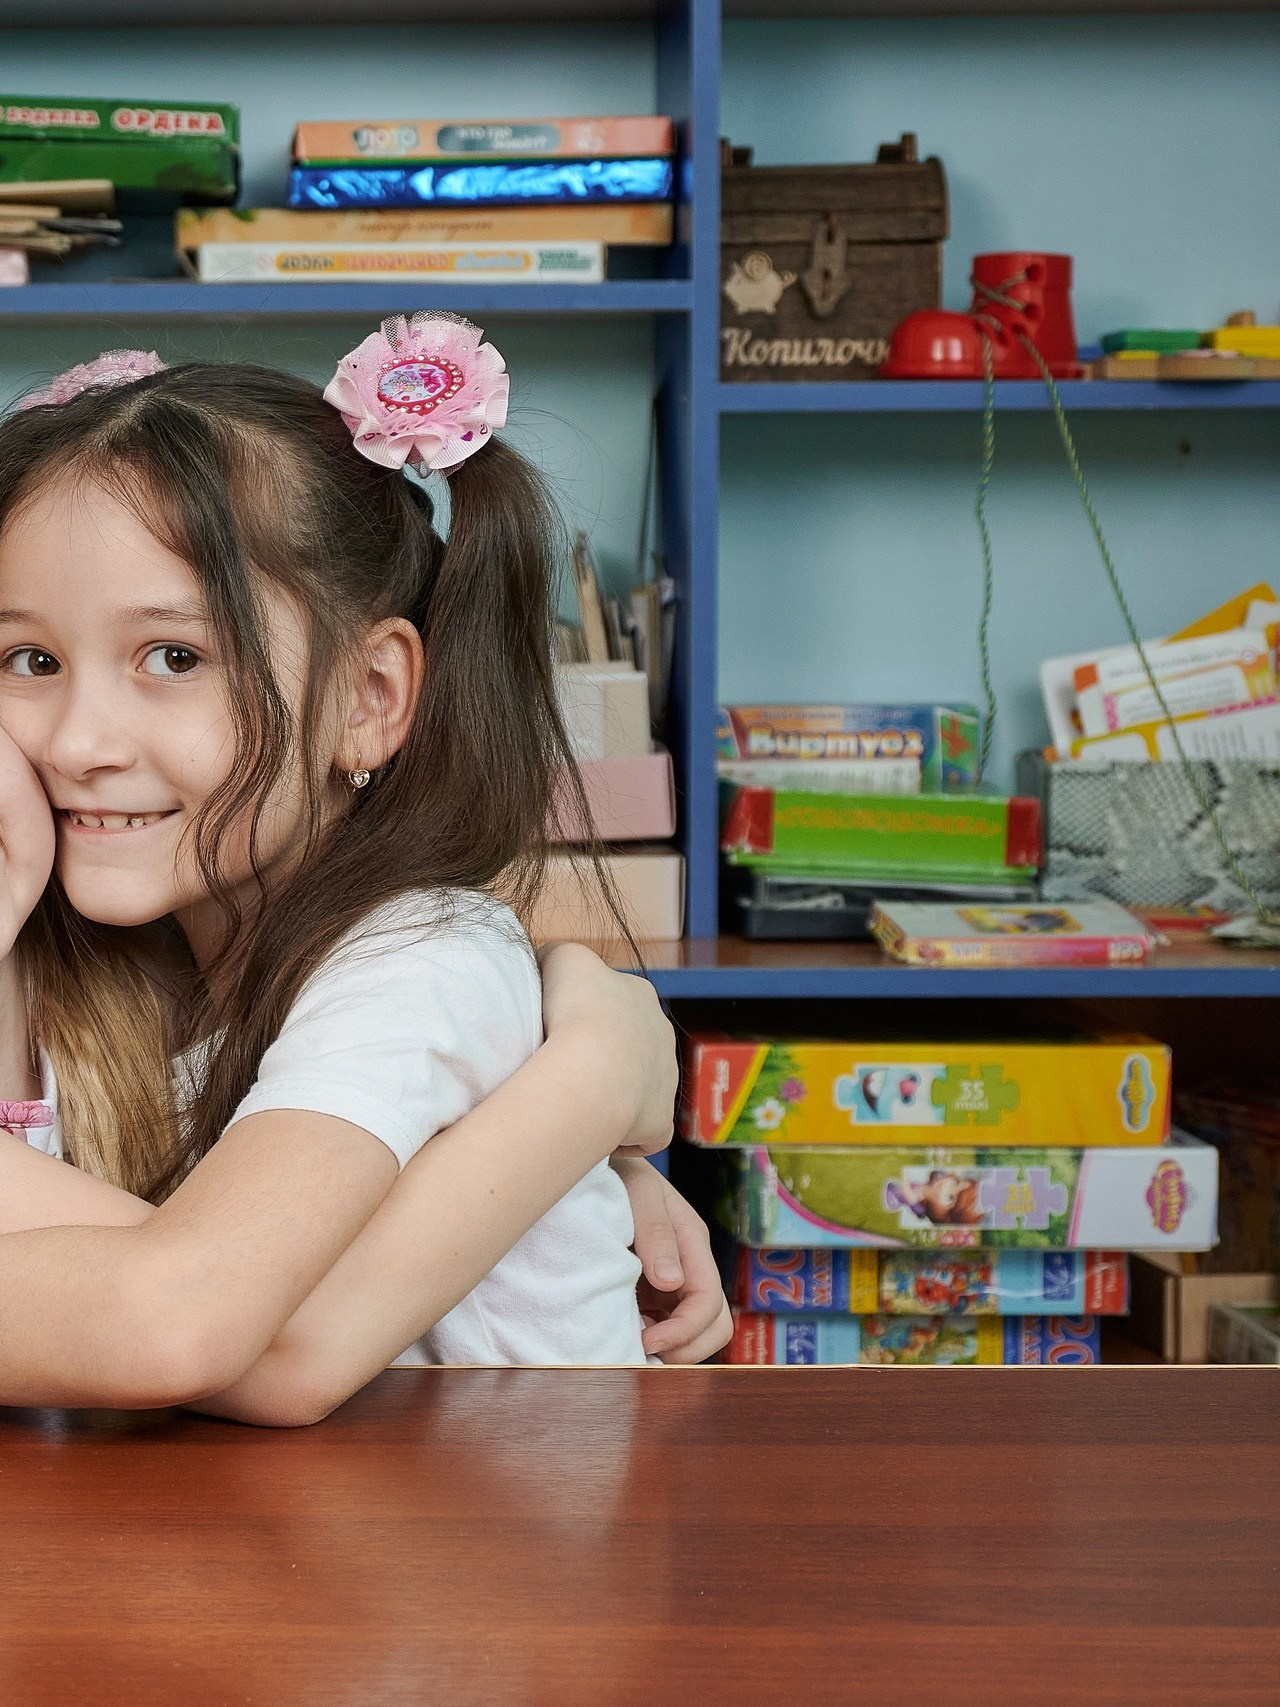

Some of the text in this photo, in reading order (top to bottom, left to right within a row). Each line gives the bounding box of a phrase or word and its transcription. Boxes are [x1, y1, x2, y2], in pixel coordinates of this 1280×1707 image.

[112, 109, 224, 136] ОРДЕНА
[722, 326, 890, 367] Копилоч
[959, 1080, 985, 1099] 35
[757, 1249, 806, 1307] 20
[811, 1250, 832, 1307] MAX
[1022, 1315, 1041, 1364] MAX
